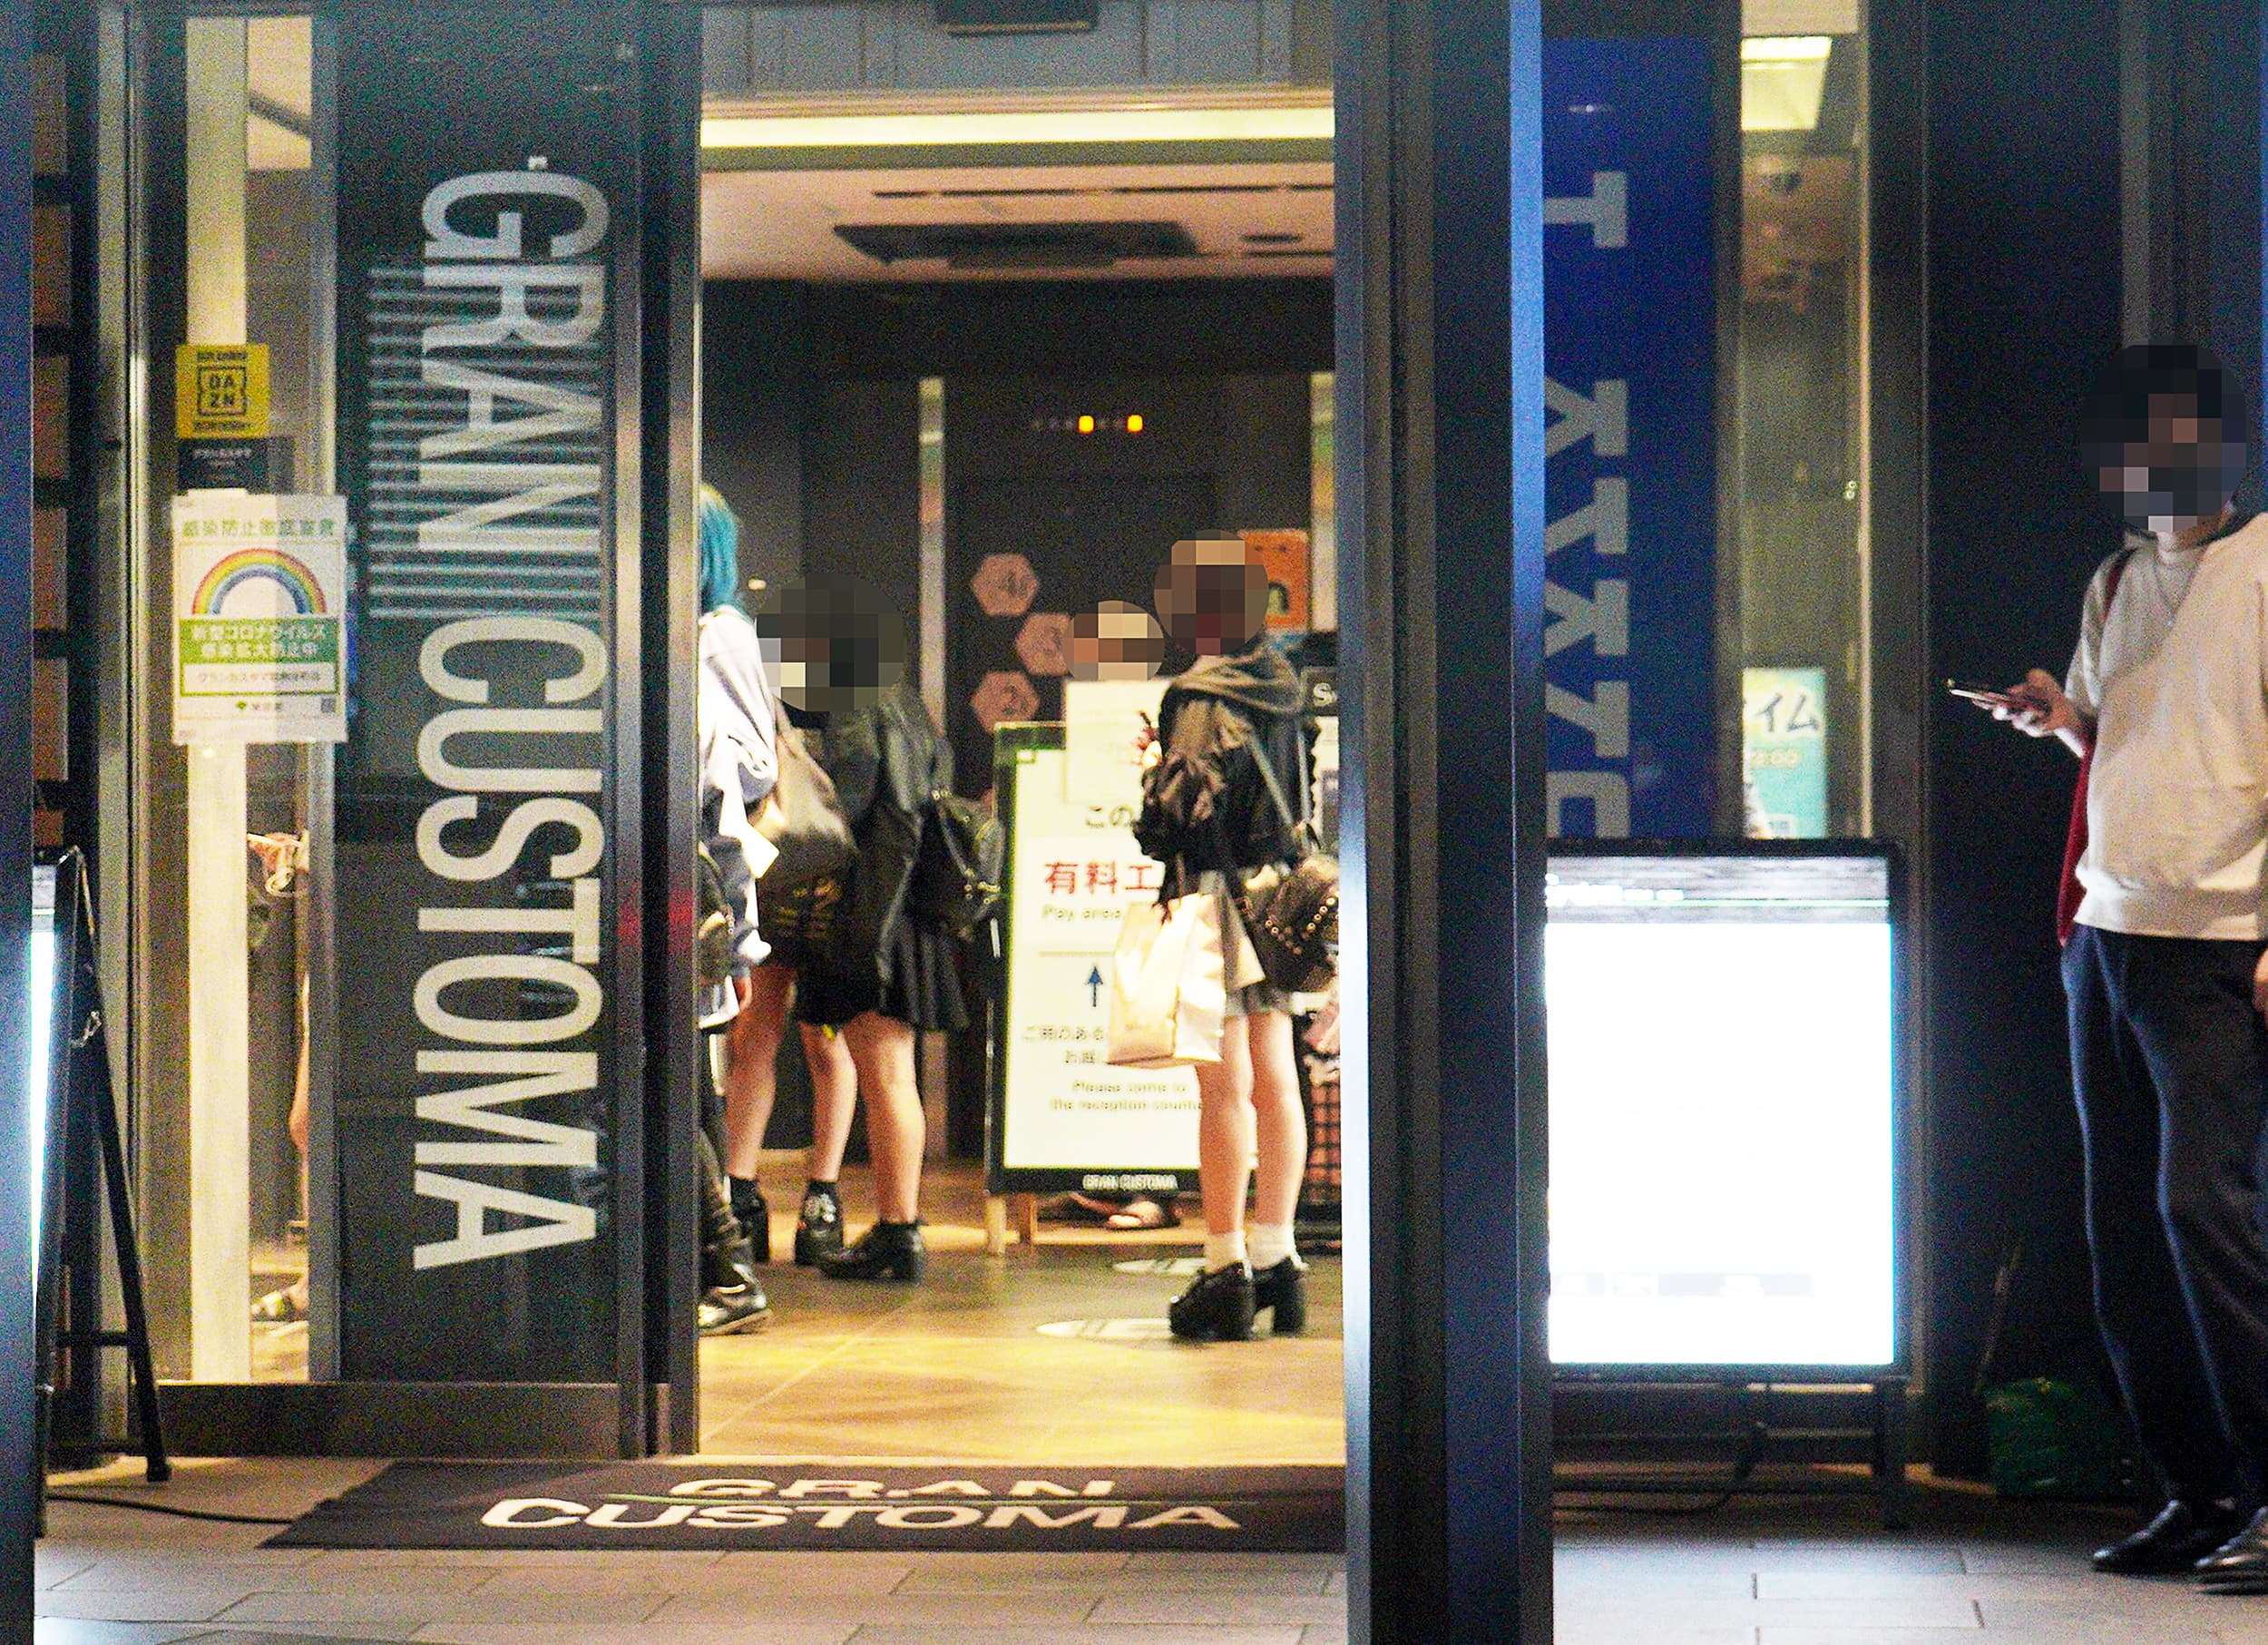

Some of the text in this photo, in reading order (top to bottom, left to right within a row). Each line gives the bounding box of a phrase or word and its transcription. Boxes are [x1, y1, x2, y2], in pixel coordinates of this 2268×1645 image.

[413, 171, 610, 1270] GRAN CUSTOMA
[1752, 692, 1820, 733] イム
[1085, 806, 1135, 828] この
[1041, 904, 1074, 922] Pay
[1071, 1080, 1121, 1093] Please
[1153, 1100, 1205, 1111] counte
[669, 1478, 1117, 1500] GRAN
[481, 1497, 1245, 1530] CUSTOMA
